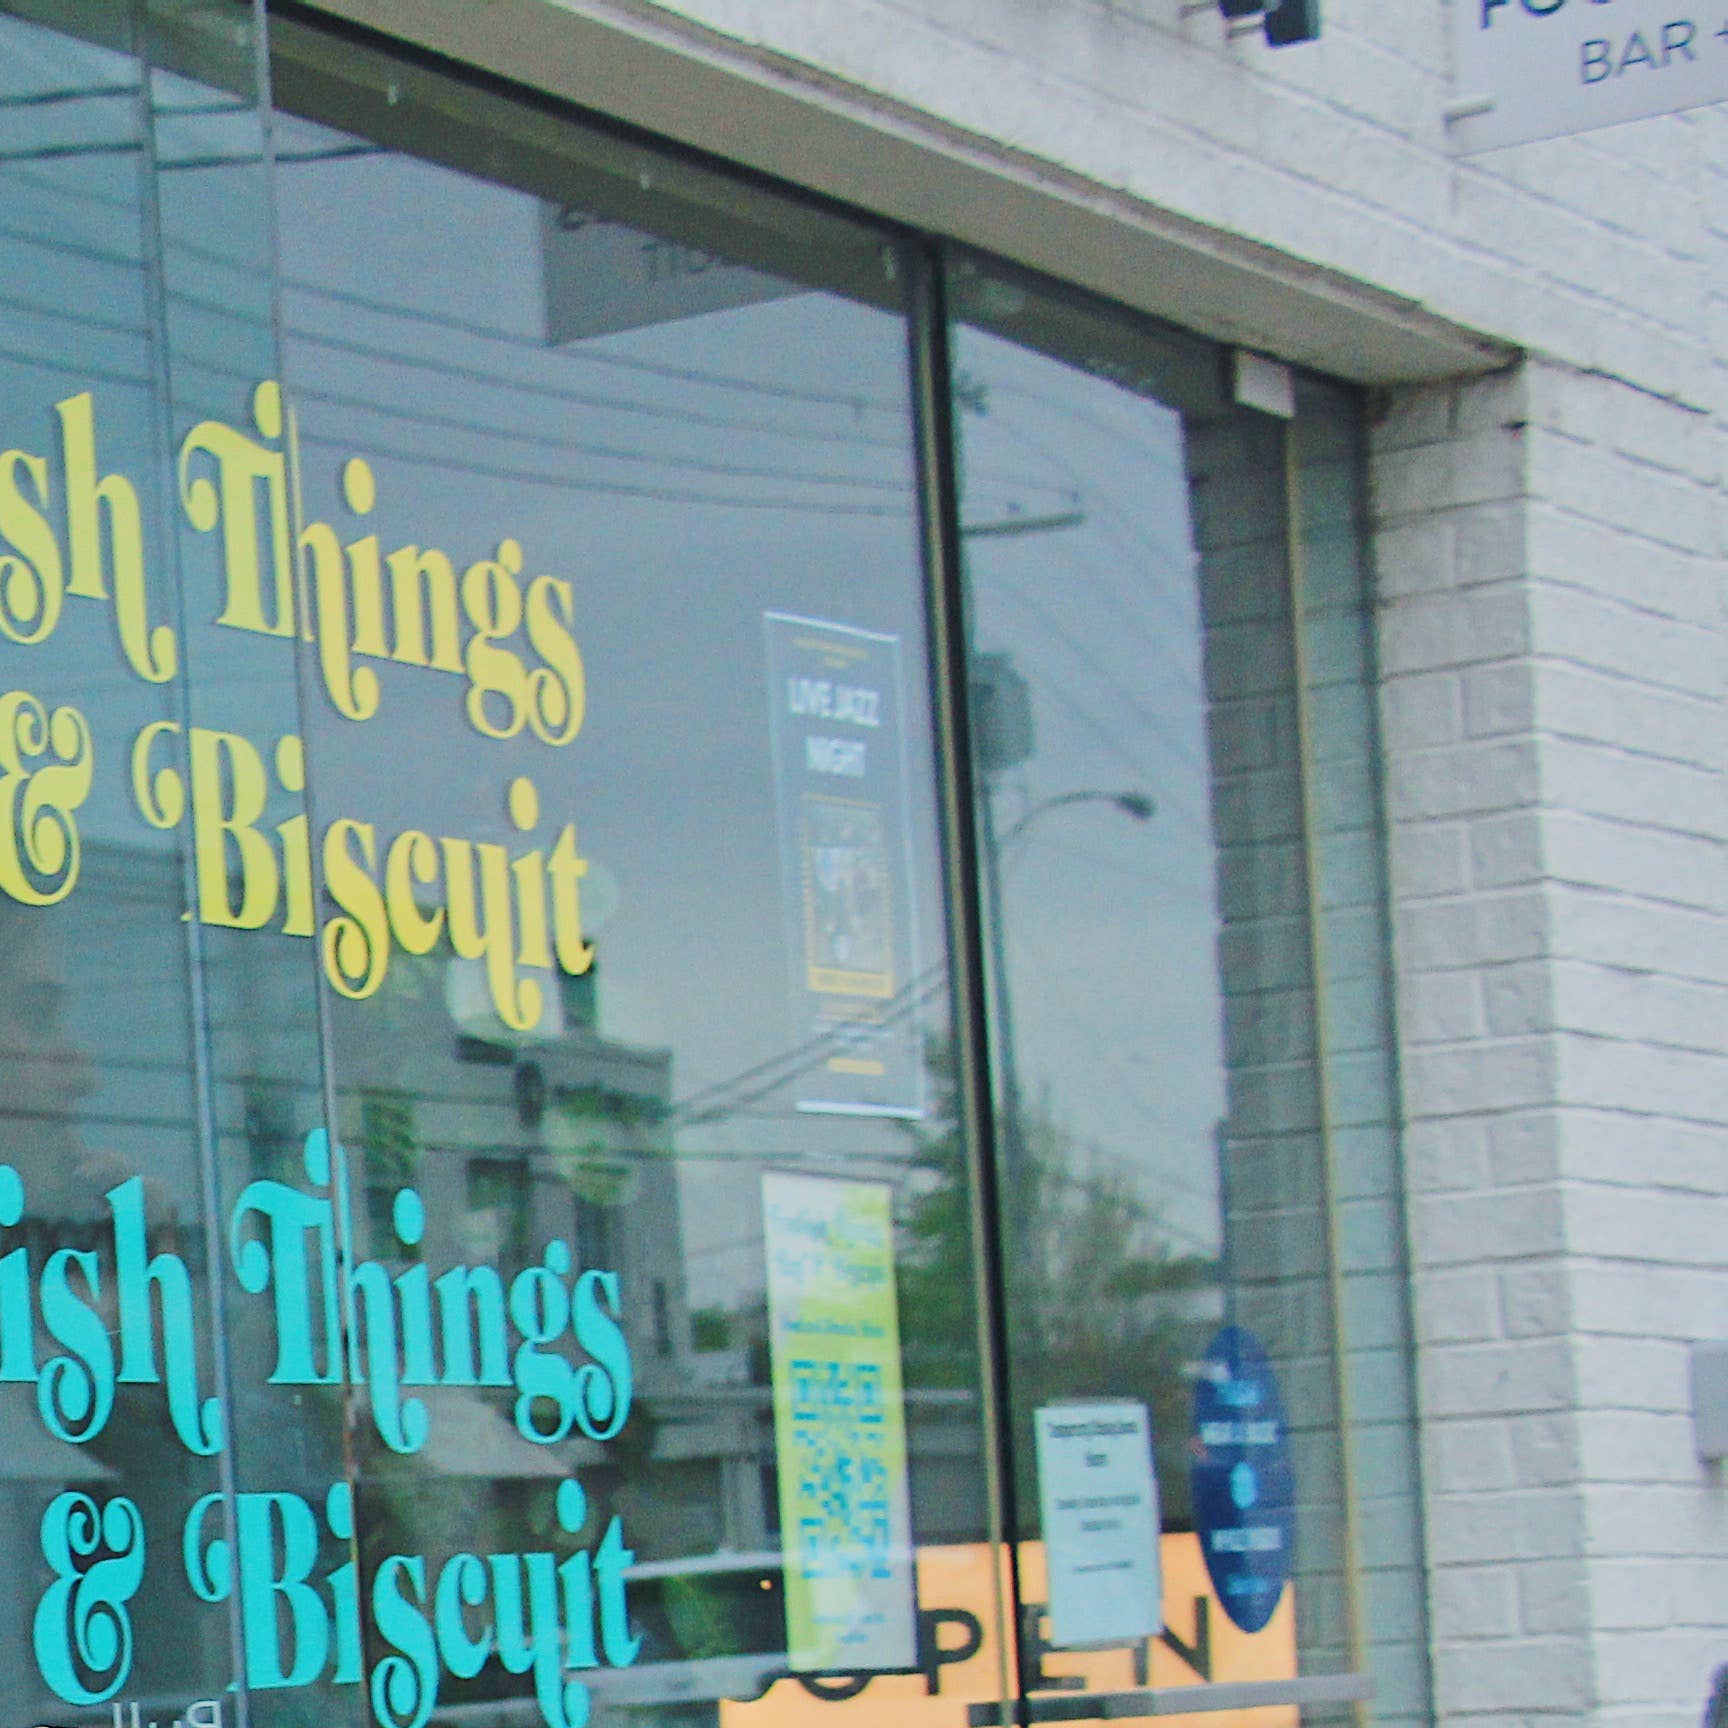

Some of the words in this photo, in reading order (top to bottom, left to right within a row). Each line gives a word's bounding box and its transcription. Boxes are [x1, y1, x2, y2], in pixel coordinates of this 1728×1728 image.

[1581, 20, 1696, 85] BAR
[181, 379, 587, 747] Things
[131, 720, 595, 1030] Biscuit
[231, 1128, 633, 1457] Things
[34, 1490, 145, 1706] &
[798, 1597, 1212, 1702] PEN
